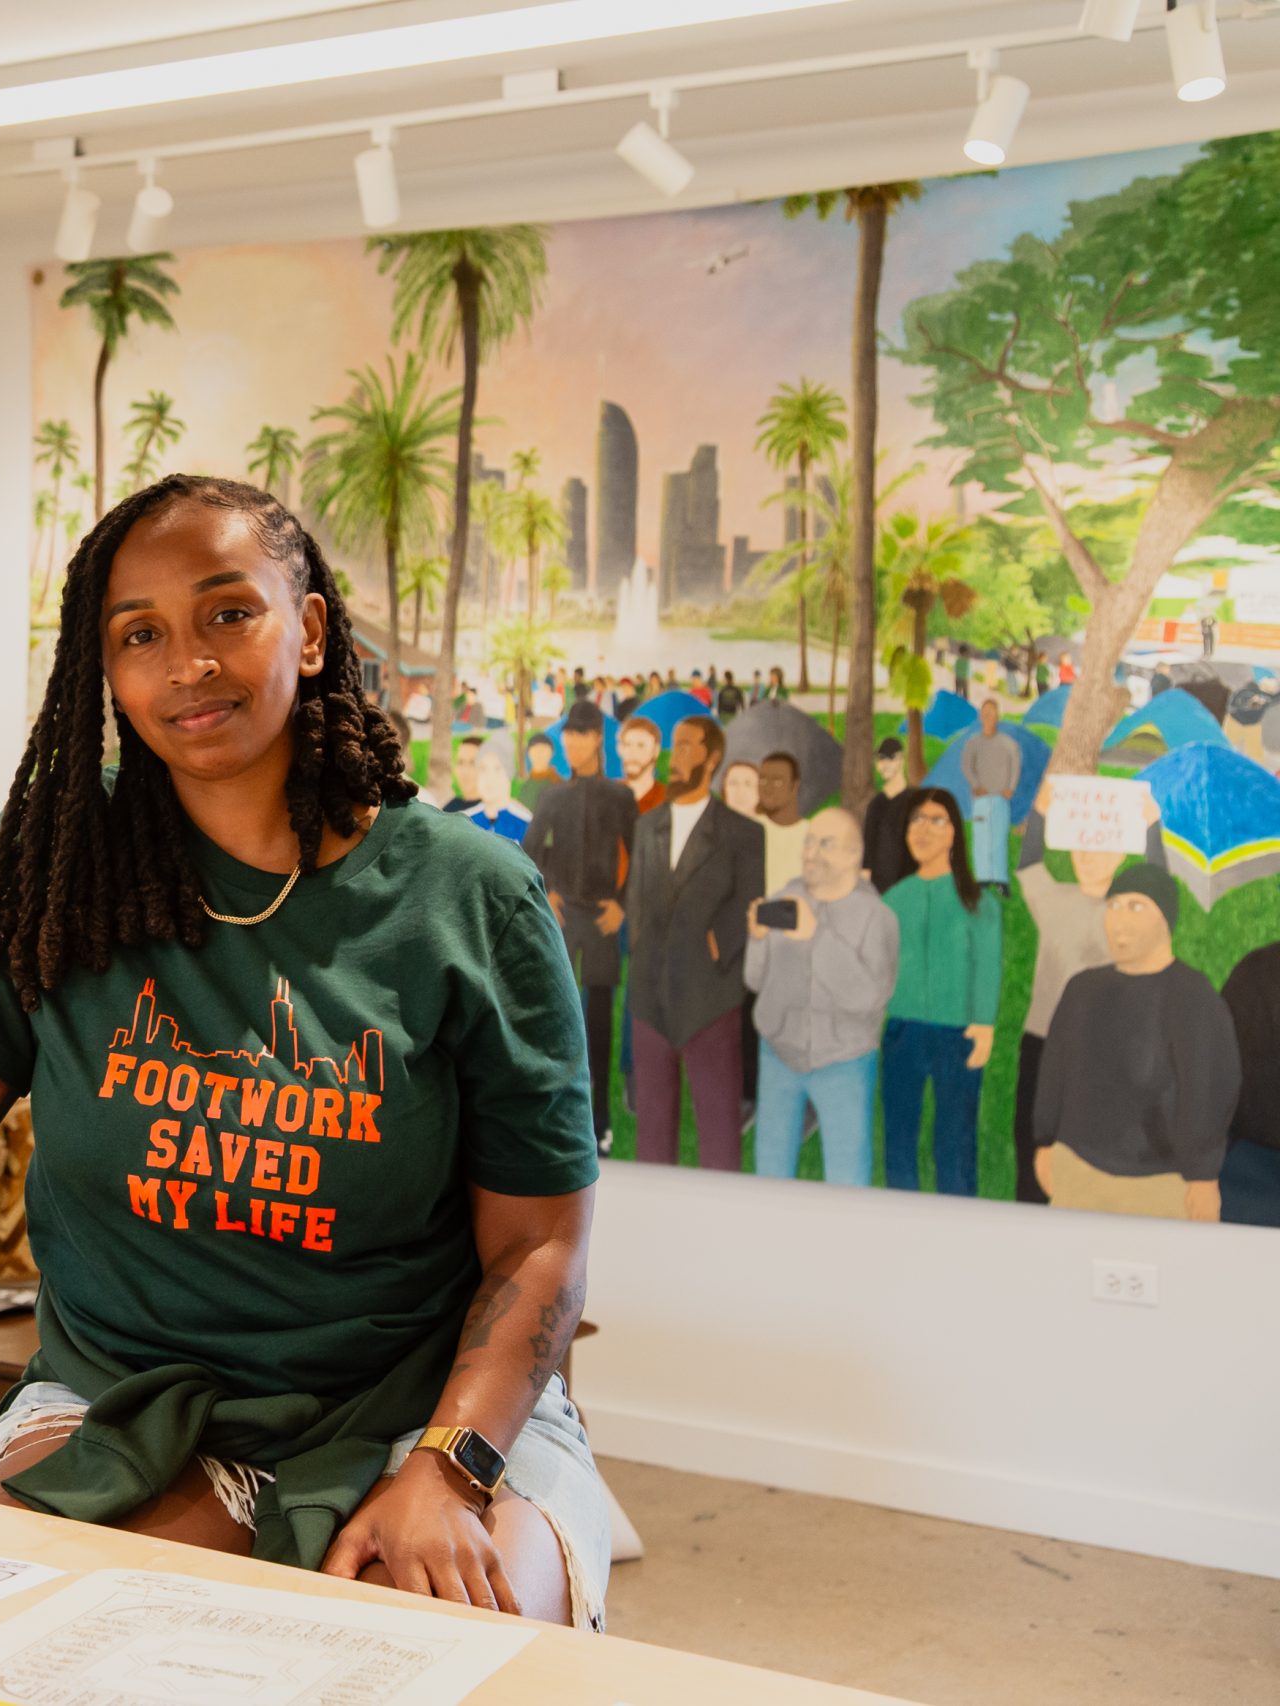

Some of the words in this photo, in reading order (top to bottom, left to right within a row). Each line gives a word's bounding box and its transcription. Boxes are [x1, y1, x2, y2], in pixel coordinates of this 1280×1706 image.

[98, 1052, 382, 1143] FOOTWORK
[146, 1119, 321, 1196] SAVED
[127, 1174, 198, 1230] MY
[215, 1190, 336, 1252] LIFE
